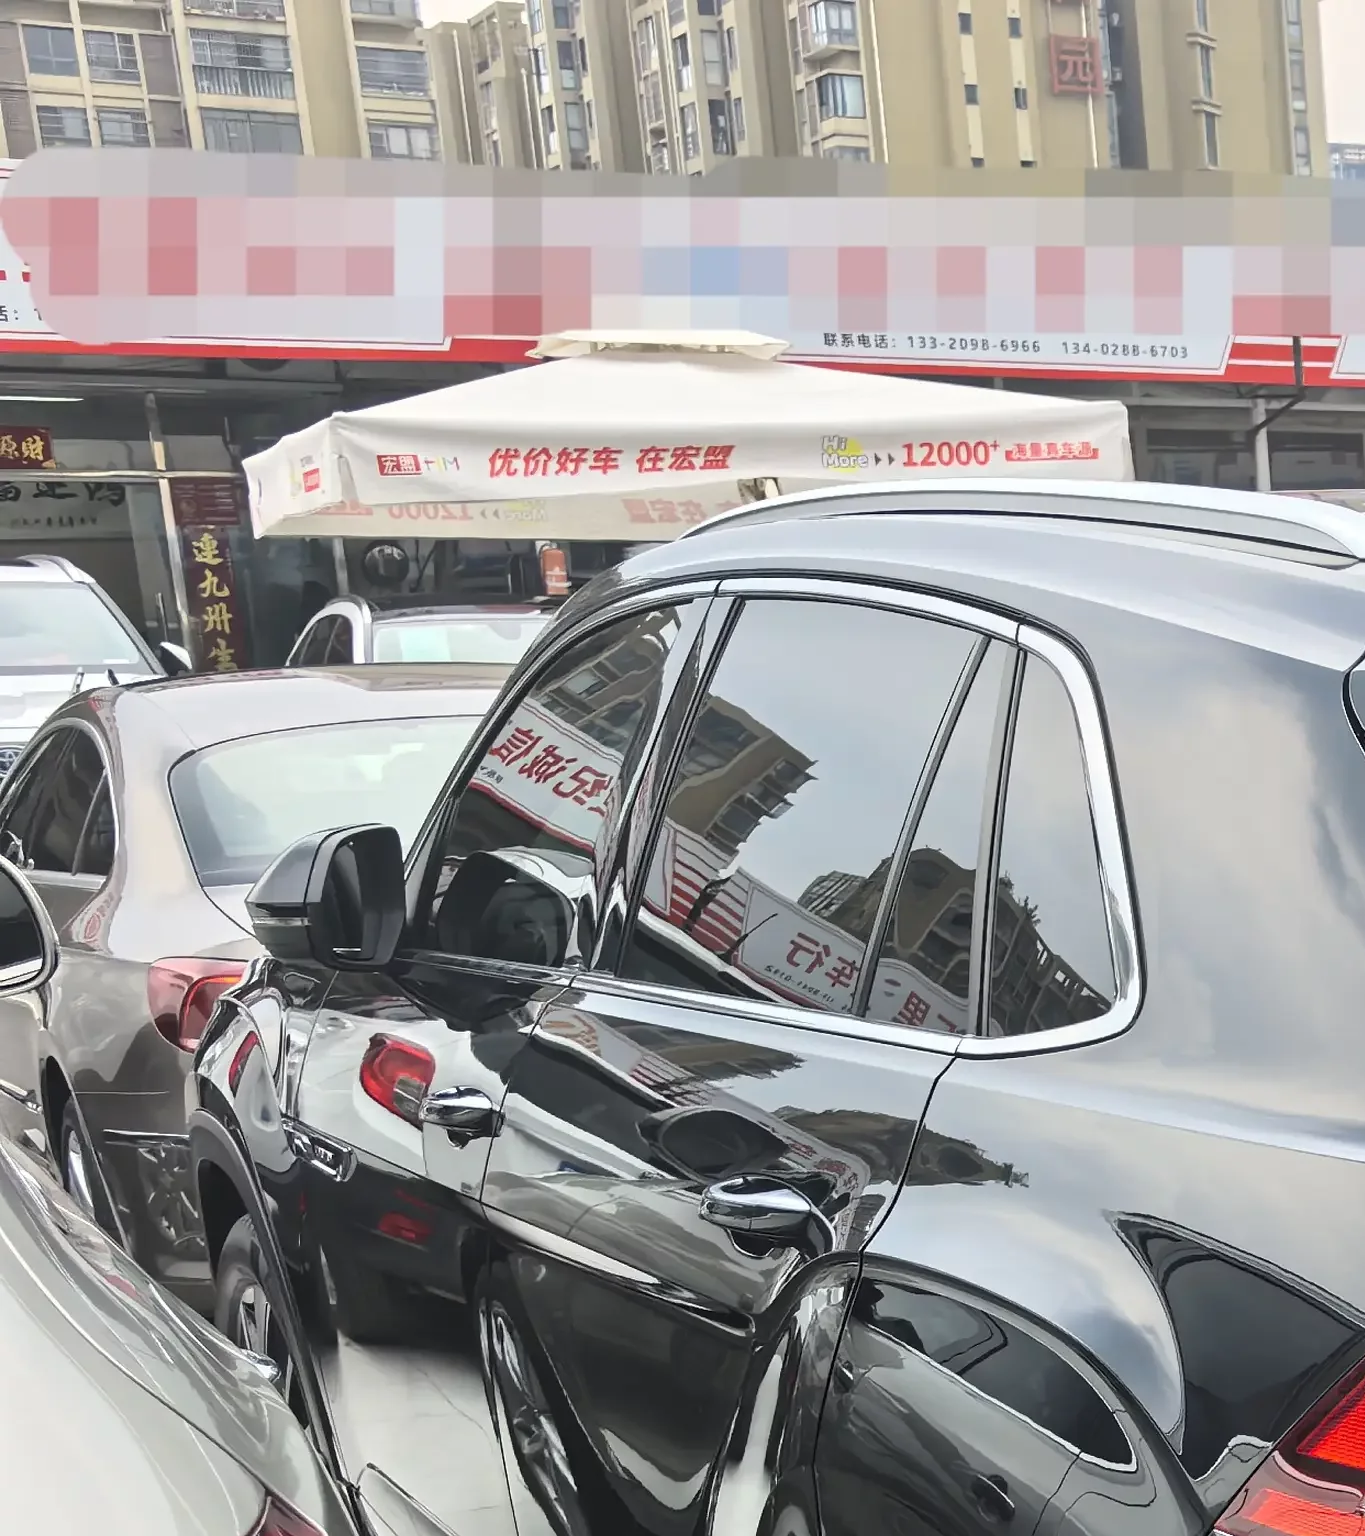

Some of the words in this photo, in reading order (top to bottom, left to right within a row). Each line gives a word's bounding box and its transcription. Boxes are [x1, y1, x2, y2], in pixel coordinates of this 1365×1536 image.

[1059, 42, 1094, 82] 元
[821, 435, 847, 452] Hi
[488, 446, 623, 478] 优价好车
[635, 444, 736, 474] 在宏盟
[821, 453, 868, 469] More
